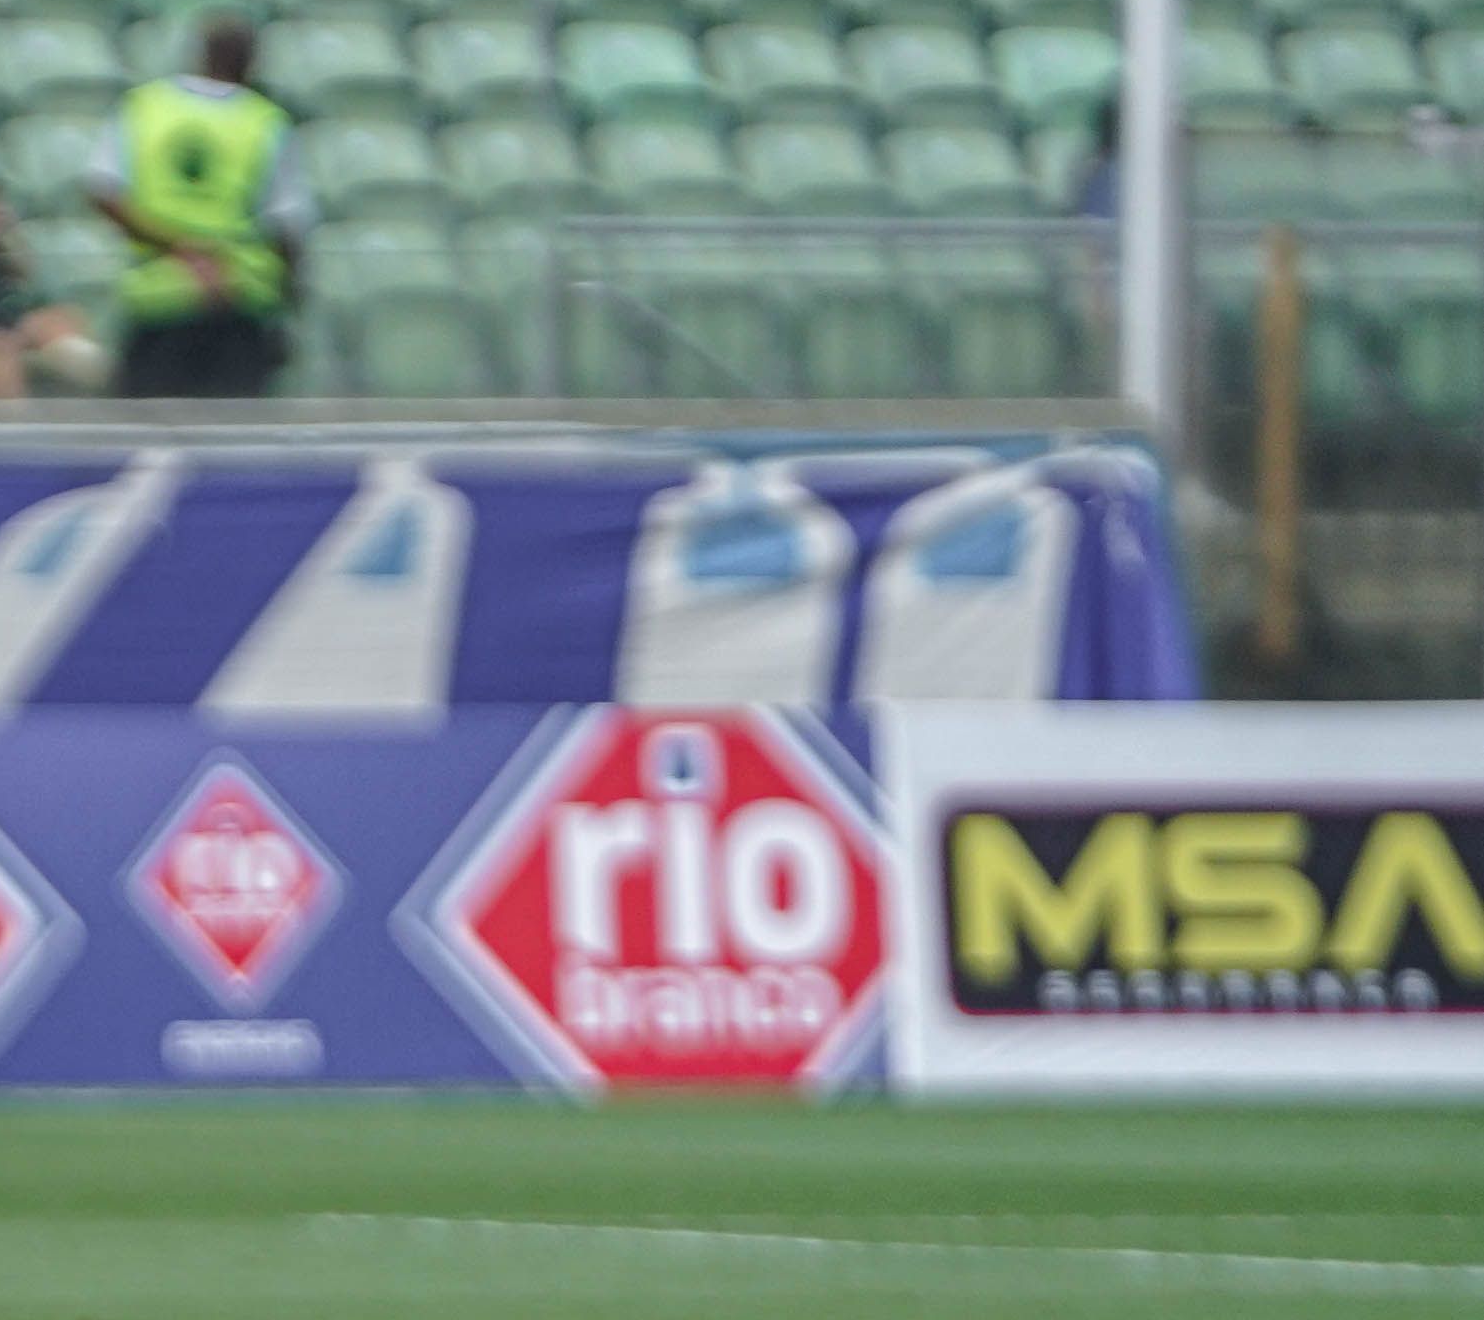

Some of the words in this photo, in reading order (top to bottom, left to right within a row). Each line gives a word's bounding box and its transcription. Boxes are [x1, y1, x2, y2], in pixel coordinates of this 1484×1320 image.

[555, 723, 849, 967] rio
[952, 809, 1484, 985] MSA
[557, 959, 839, 1049] branco
